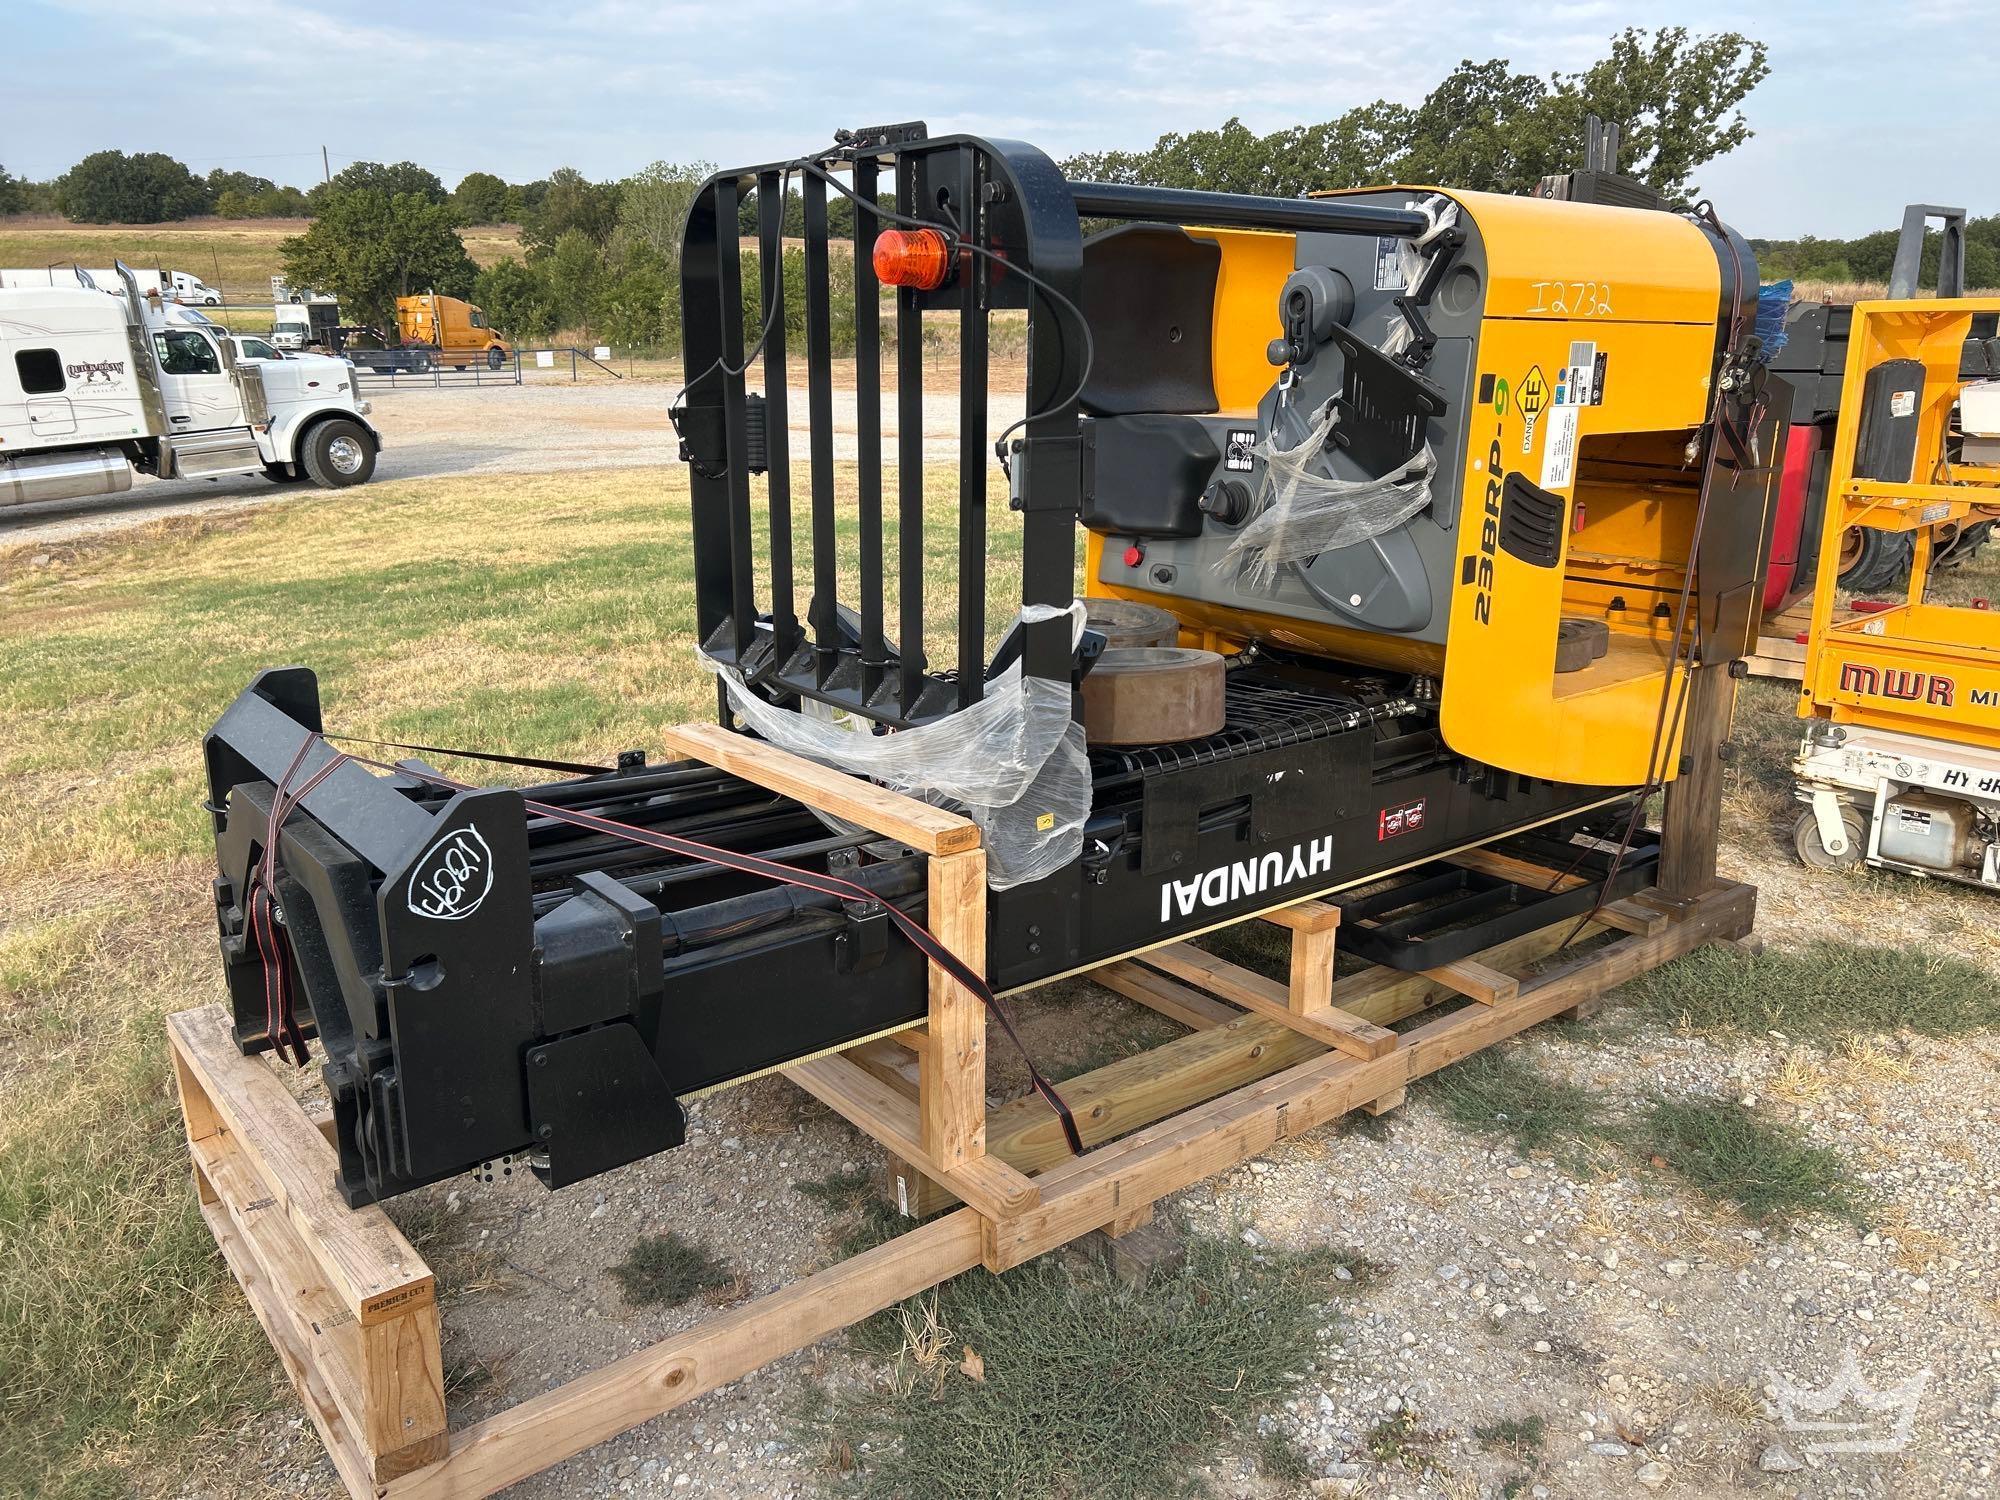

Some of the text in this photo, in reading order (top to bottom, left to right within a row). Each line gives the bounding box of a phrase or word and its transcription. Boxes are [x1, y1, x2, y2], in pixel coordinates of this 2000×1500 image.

[1526, 281, 1613, 315] I2732
[1475, 377, 1510, 625] 23BRP-9
[1840, 662, 1998, 707] MWR MI
[1160, 835, 1333, 923] HYUNDAI
